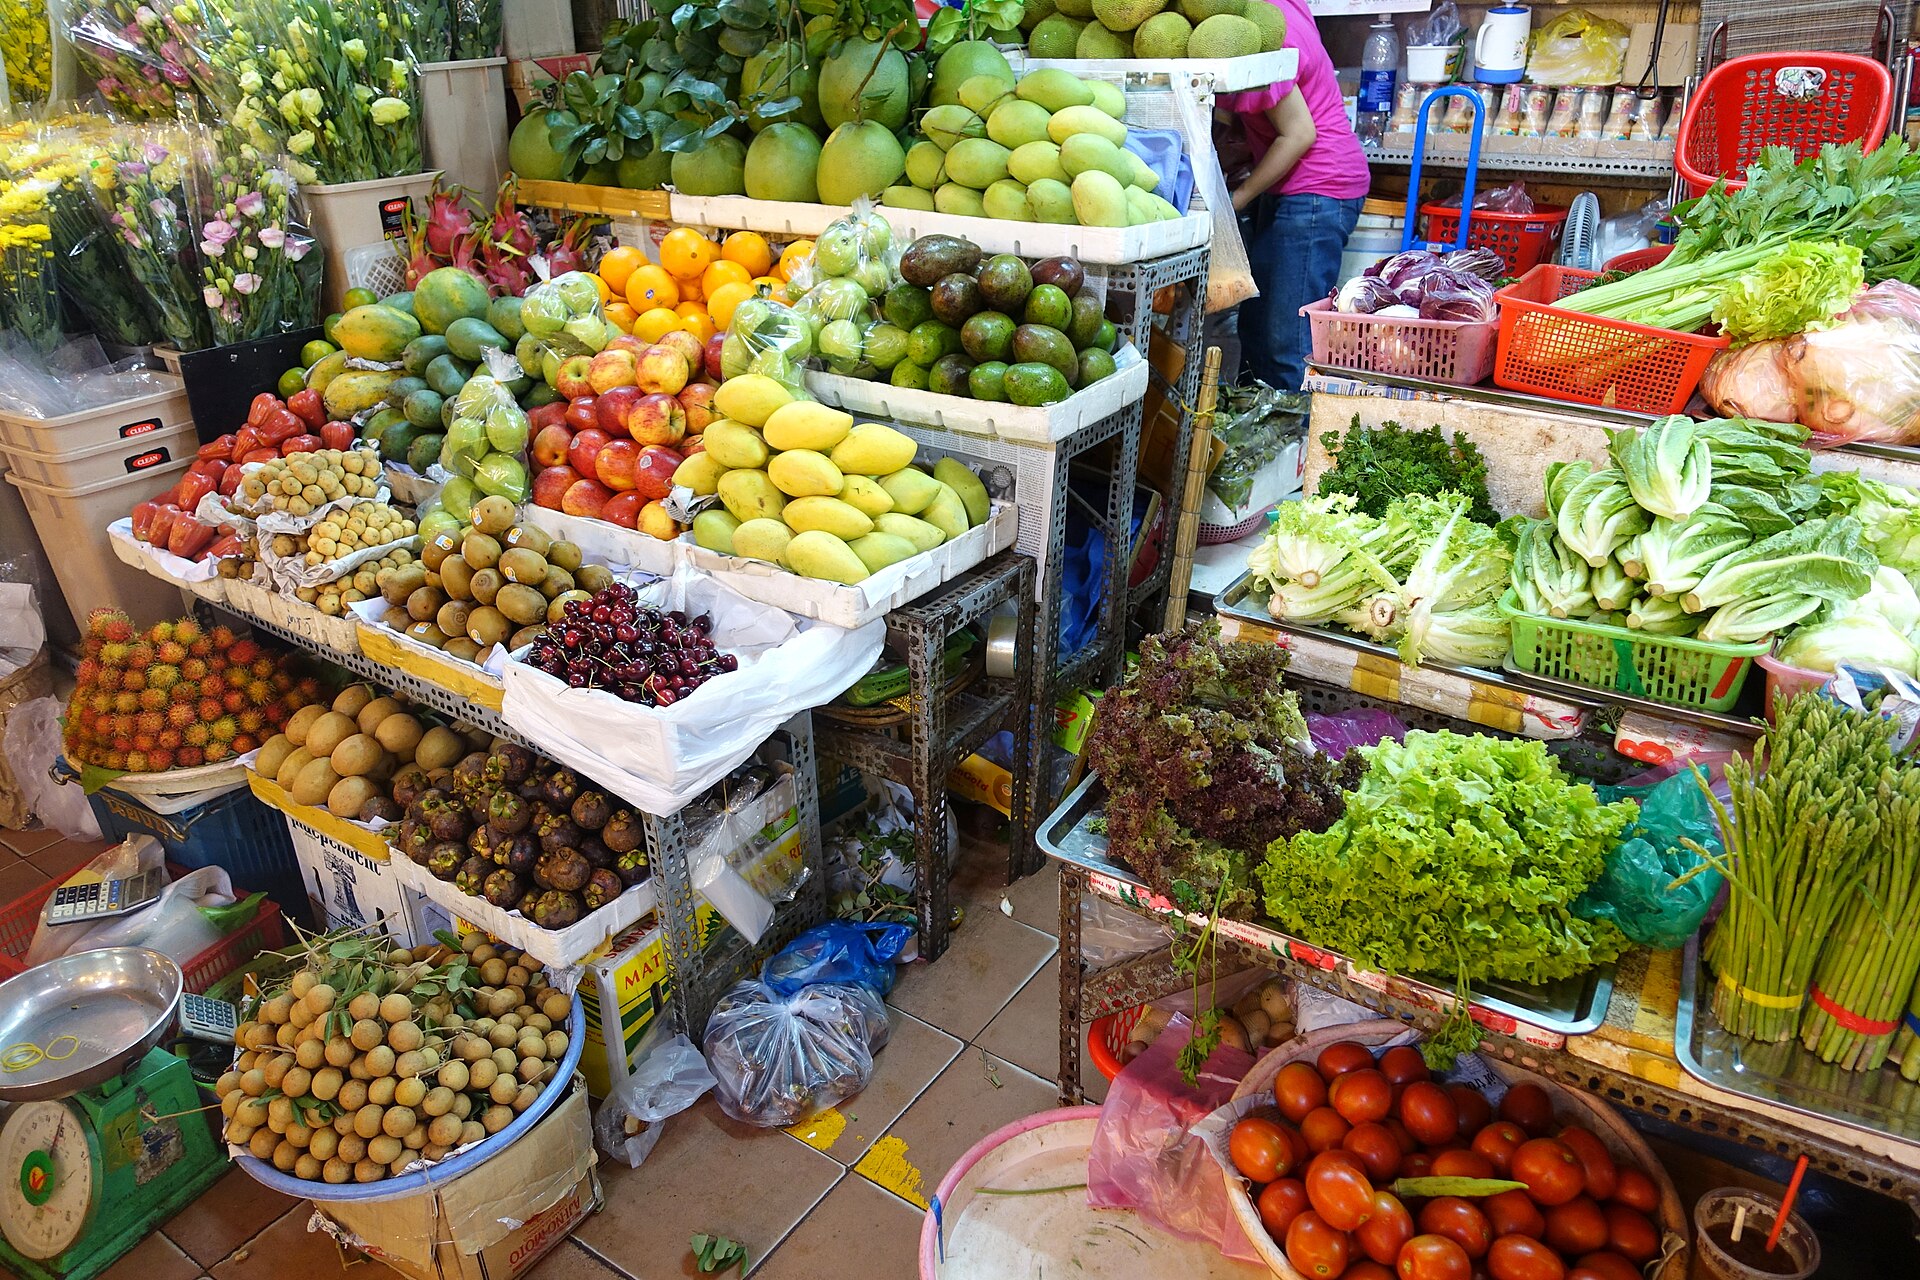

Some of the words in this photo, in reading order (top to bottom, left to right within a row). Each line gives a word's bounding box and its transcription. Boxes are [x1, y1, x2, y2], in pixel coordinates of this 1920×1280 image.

[129, 424, 152, 435] CLEAN
[137, 454, 158, 466] CLEAN
[624, 951, 661, 991] MAT
[508, 1195, 581, 1265] AJI-NO-MOTO
